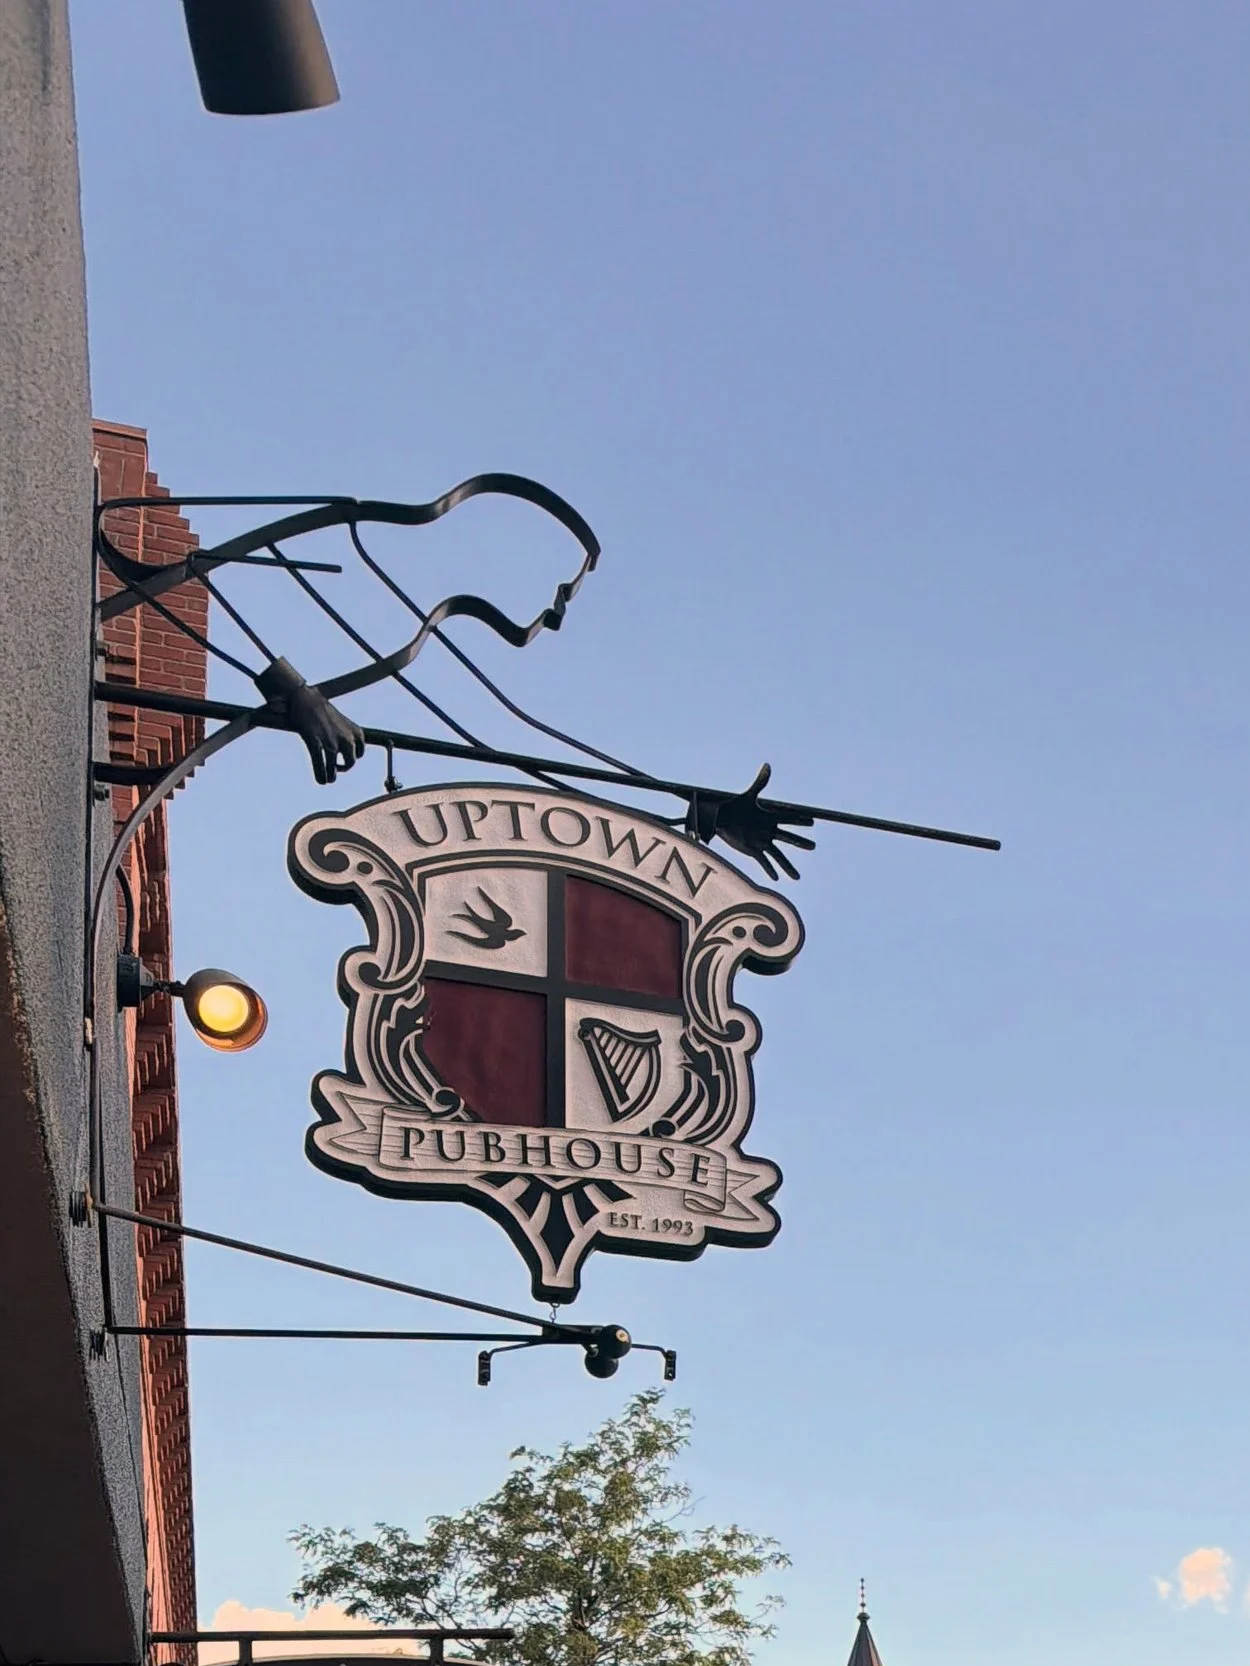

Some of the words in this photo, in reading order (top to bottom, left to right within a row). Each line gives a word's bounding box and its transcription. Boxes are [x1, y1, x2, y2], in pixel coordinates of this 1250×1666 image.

[399, 799, 719, 900] UPTOWN
[400, 1126, 713, 1187] PUBHOUSE
[607, 1211, 648, 1233] EST.
[651, 1215, 694, 1236] 1993
